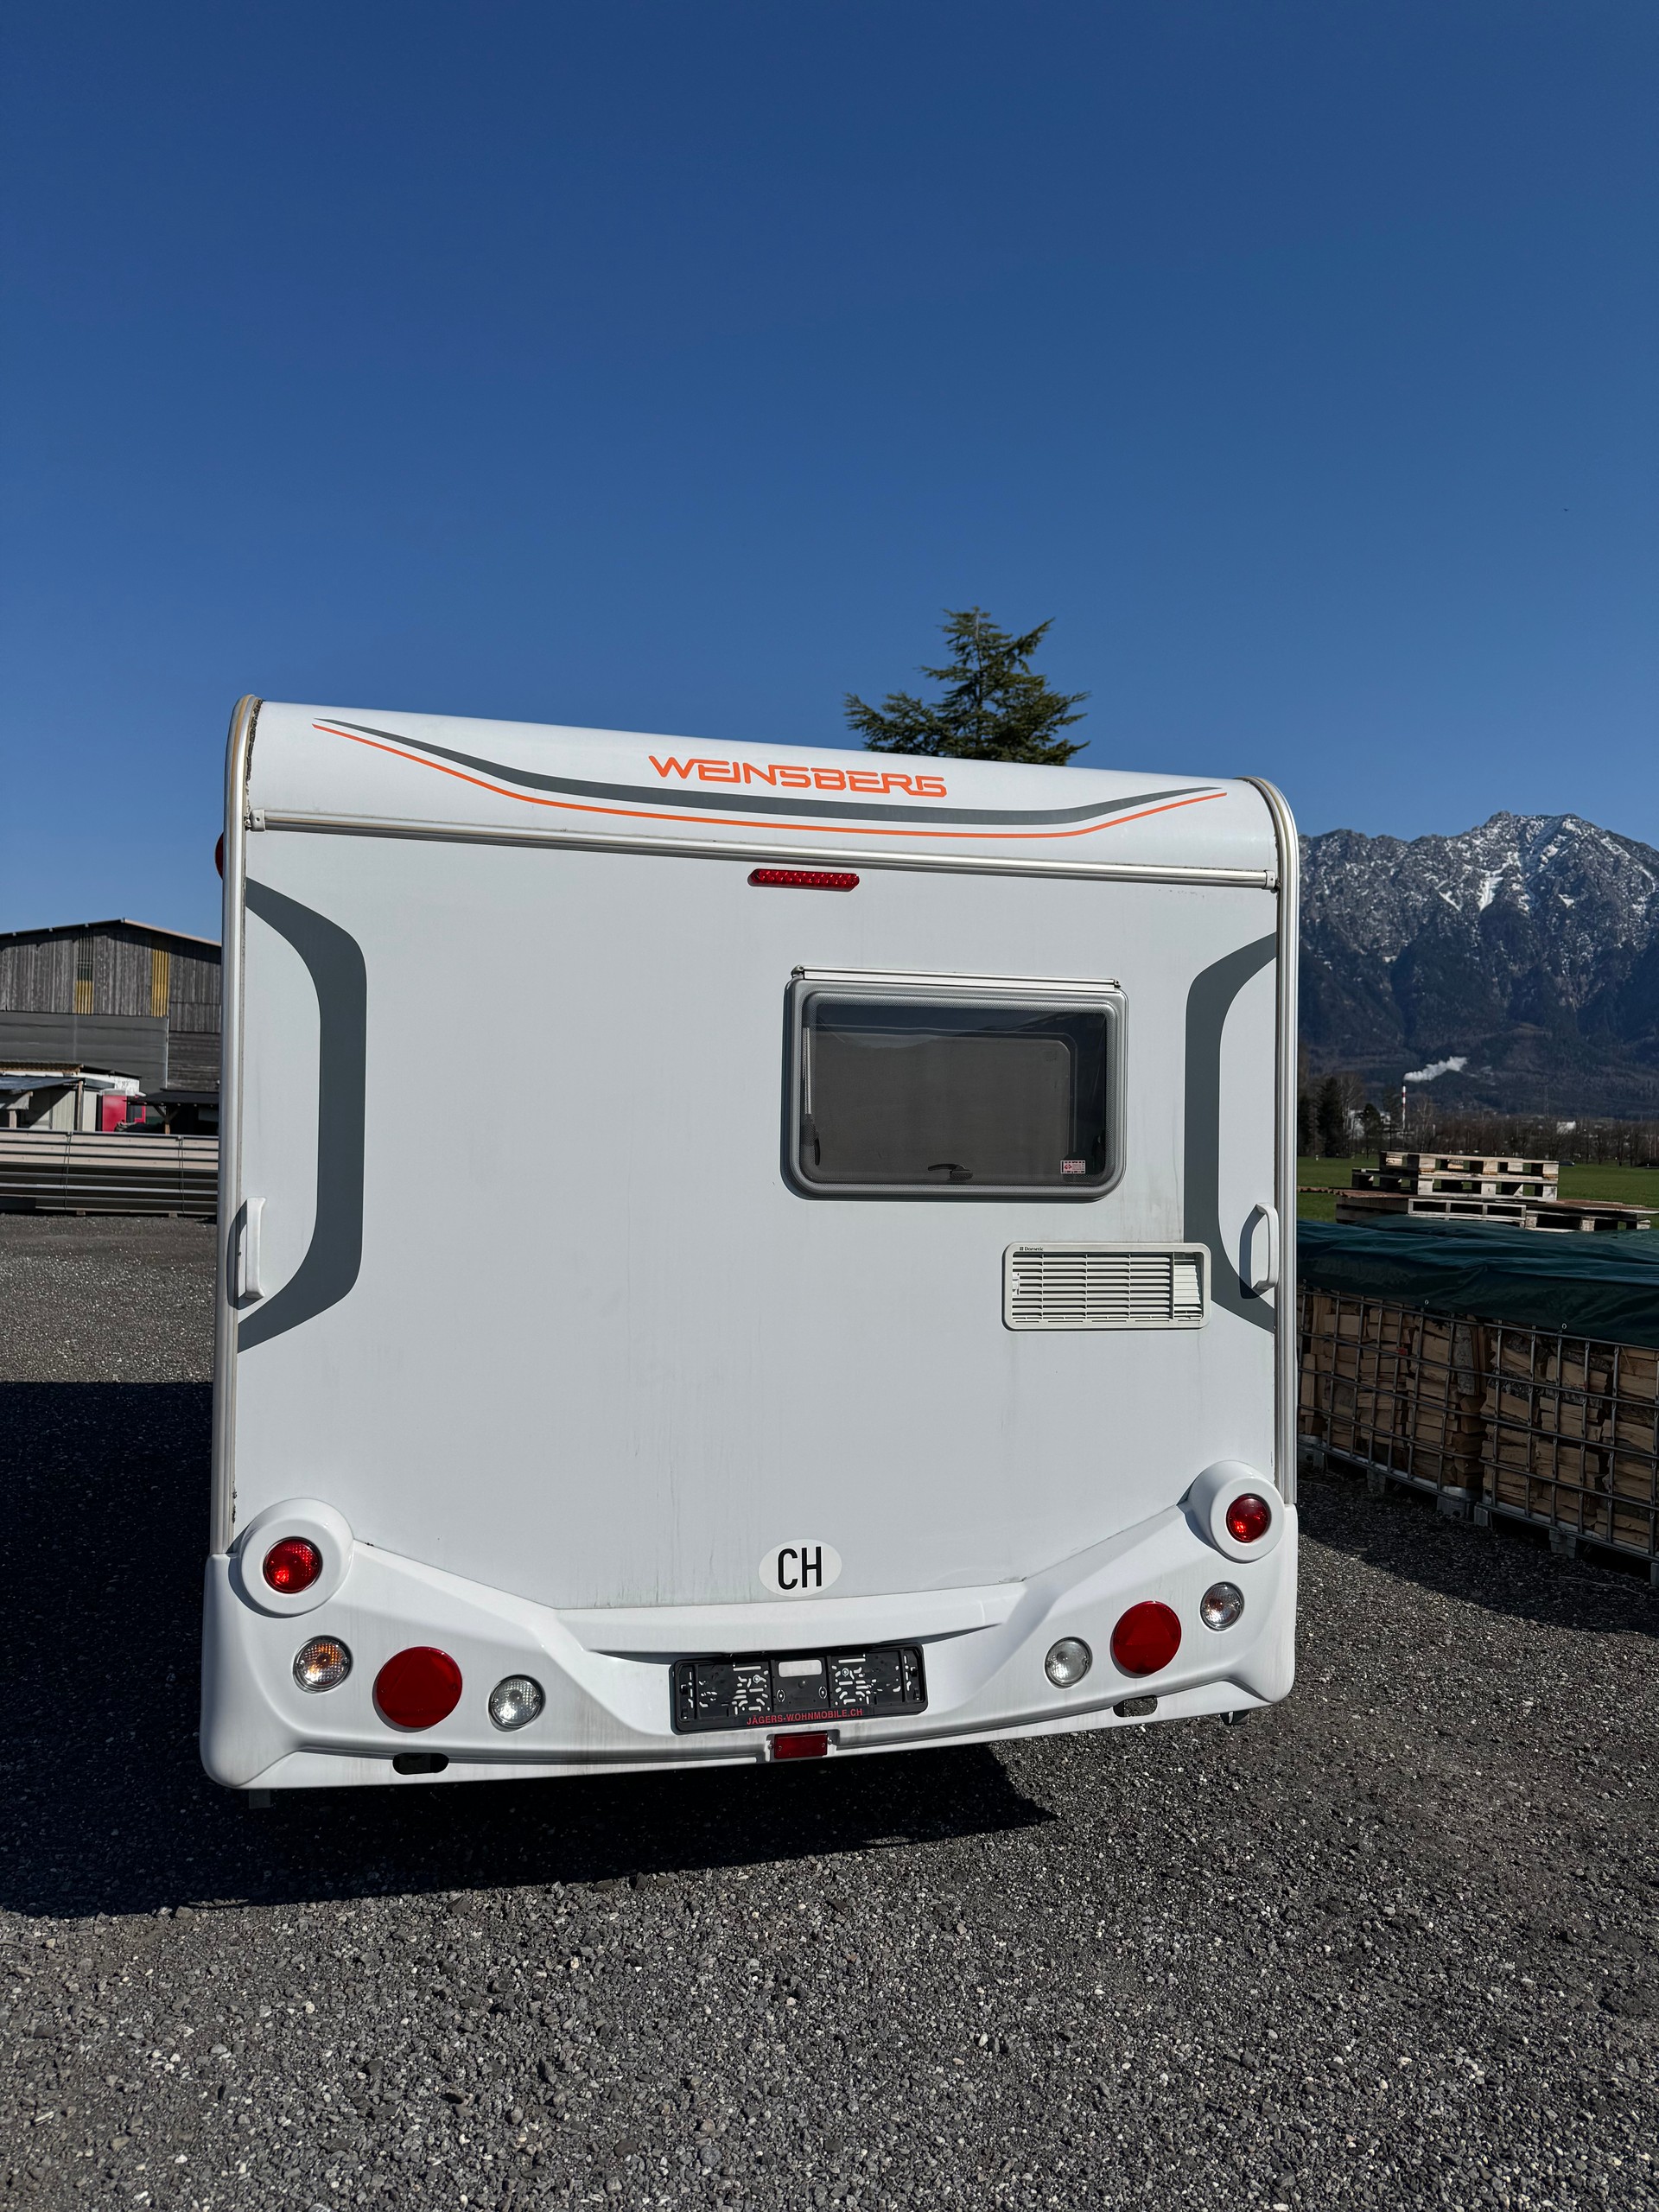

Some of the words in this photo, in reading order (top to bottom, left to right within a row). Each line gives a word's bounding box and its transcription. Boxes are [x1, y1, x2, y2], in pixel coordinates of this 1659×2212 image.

[648, 755, 948, 798] WEINSBERG
[778, 1546, 822, 1590] CH
[747, 1708, 863, 1726] JÄGERS-WOHNMOBILE.CH
